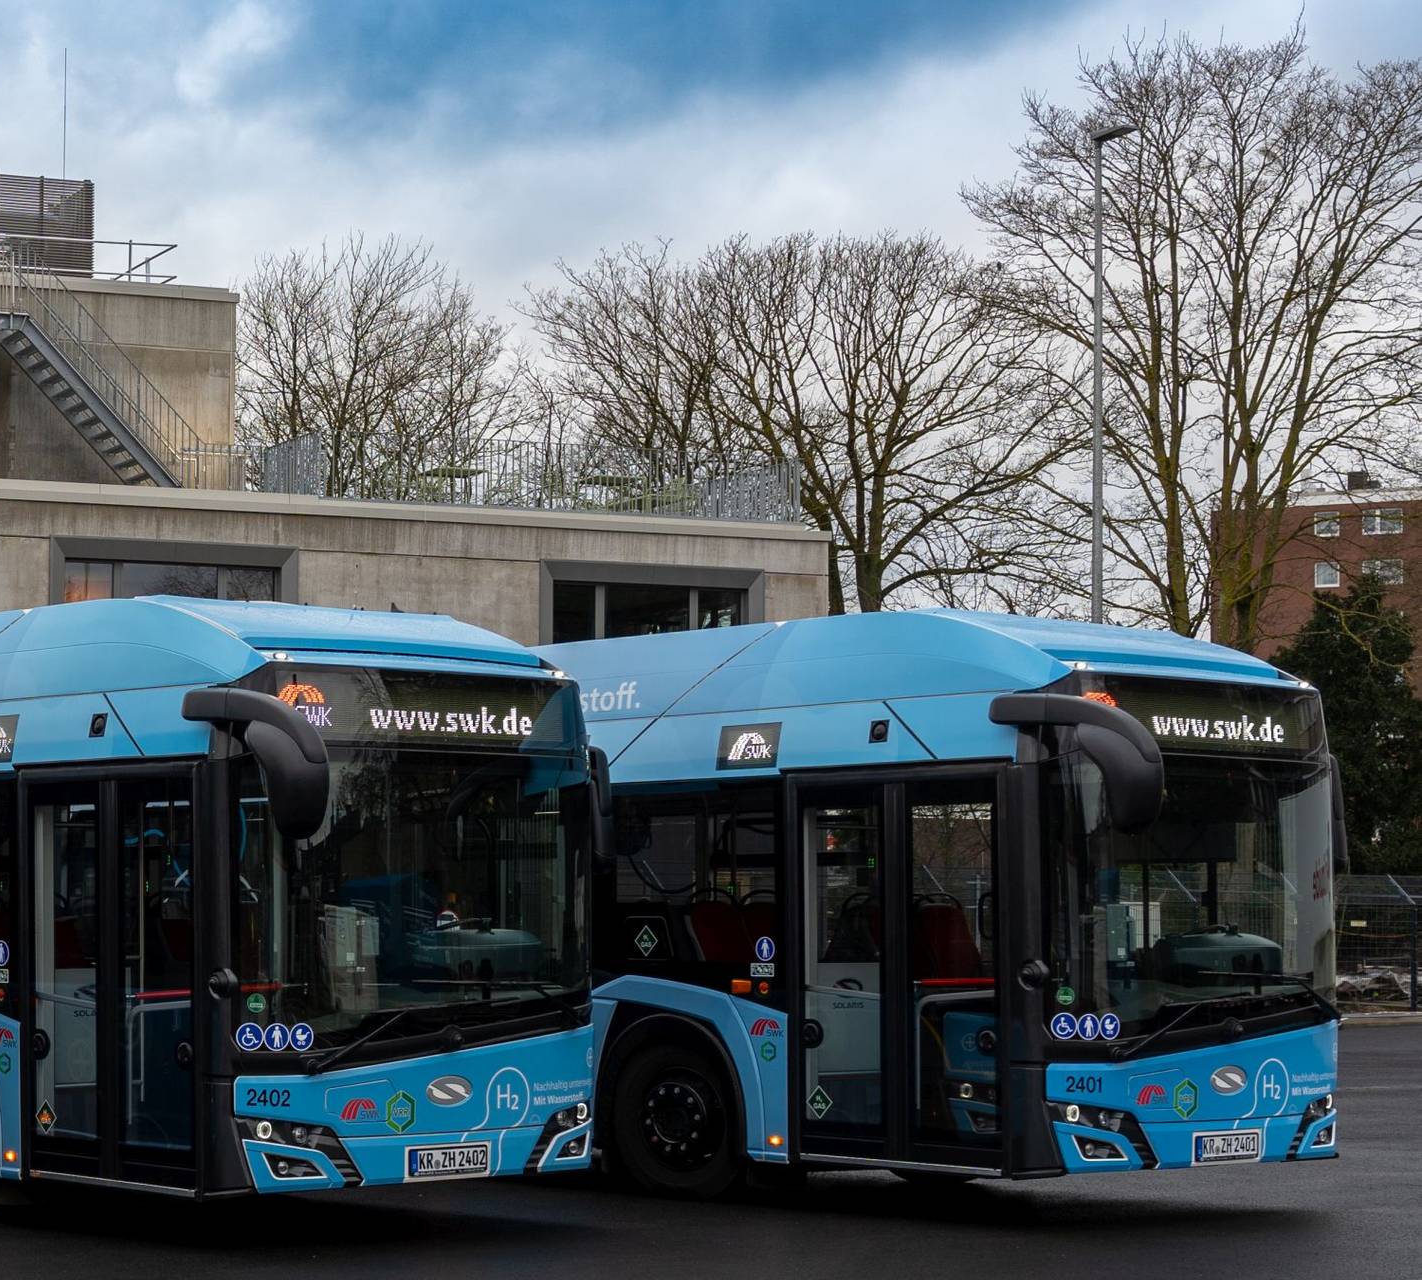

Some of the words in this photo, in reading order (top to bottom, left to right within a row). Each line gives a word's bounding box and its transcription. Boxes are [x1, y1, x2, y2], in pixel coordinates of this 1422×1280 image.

[370, 706, 532, 736] www.swk.de
[1152, 715, 1284, 743] www.swk.de
[744, 744, 772, 760] SWK
[766, 1030, 784, 1038] SWK
[1065, 1076, 1103, 1093] 2401
[246, 1089, 291, 1107] 2402
[813, 1102, 827, 1110] GAS
[1203, 1139, 1215, 1154] KR
[1221, 1138, 1233, 1153] ZH
[1234, 1136, 1256, 1152] 2401
[419, 1153, 434, 1170] KR
[441, 1151, 456, 1168] ZH
[458, 1149, 486, 1167] 2402
